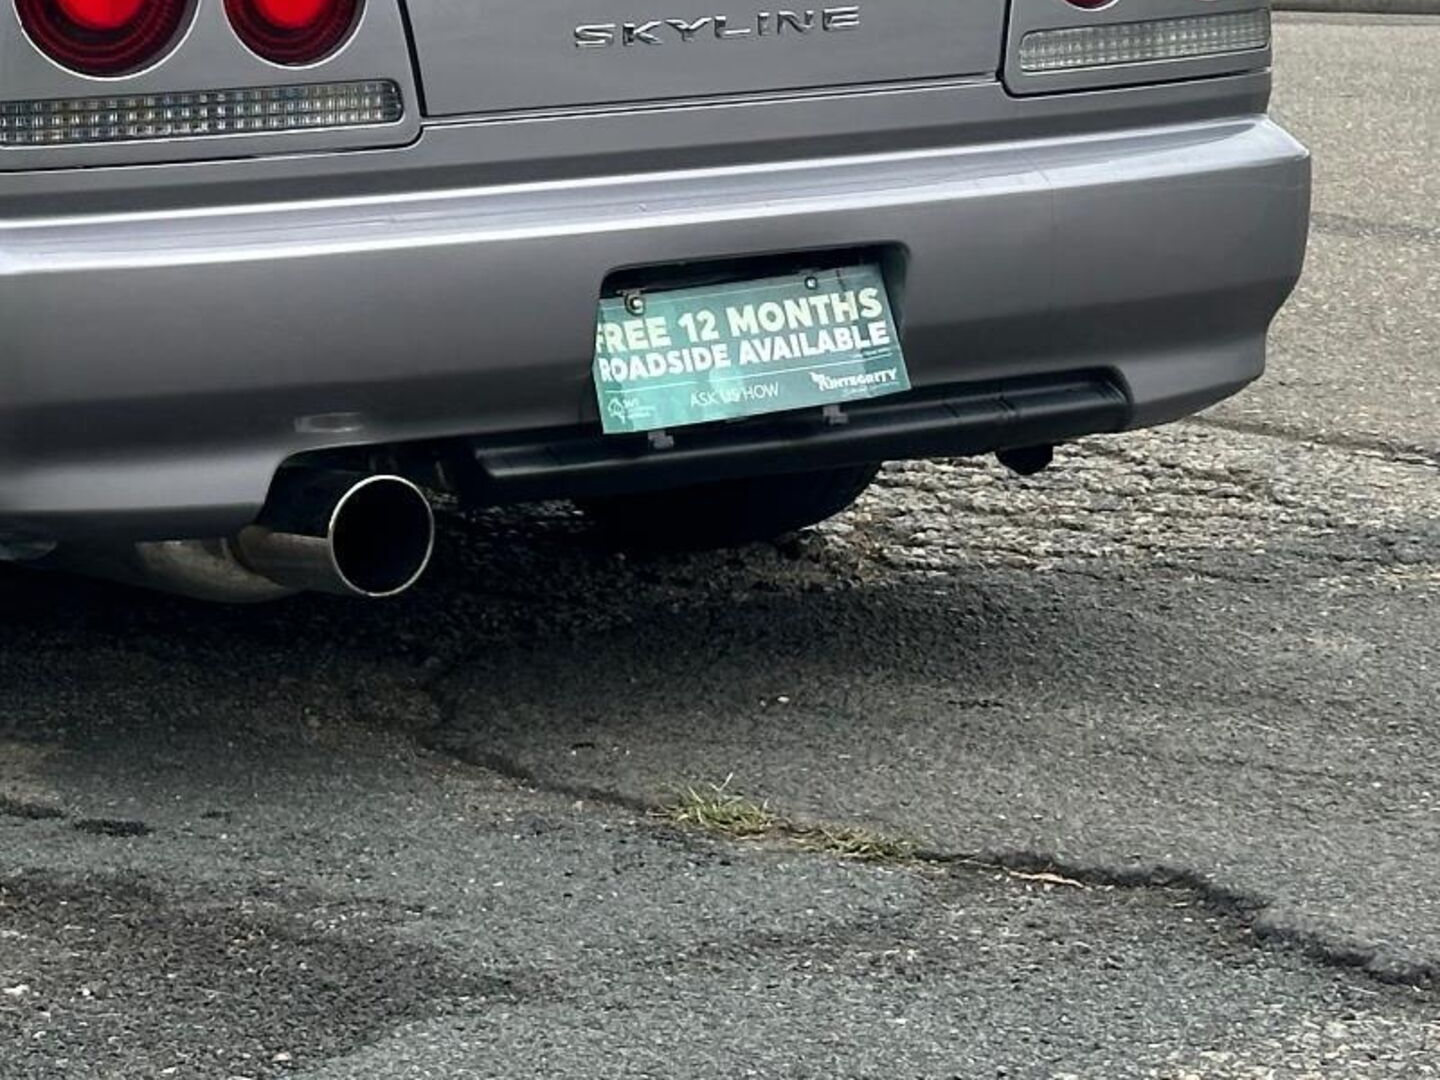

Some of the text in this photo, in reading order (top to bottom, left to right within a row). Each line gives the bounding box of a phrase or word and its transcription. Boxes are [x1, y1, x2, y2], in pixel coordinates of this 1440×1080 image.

[573, 5, 861, 48] SKYLINE
[677, 309, 720, 343] 12
[727, 287, 883, 337] MONTHS
[597, 320, 891, 383] ROADSIDE AVAILABLE
[690, 390, 718, 408] ASK
[743, 381, 779, 401] HOW
